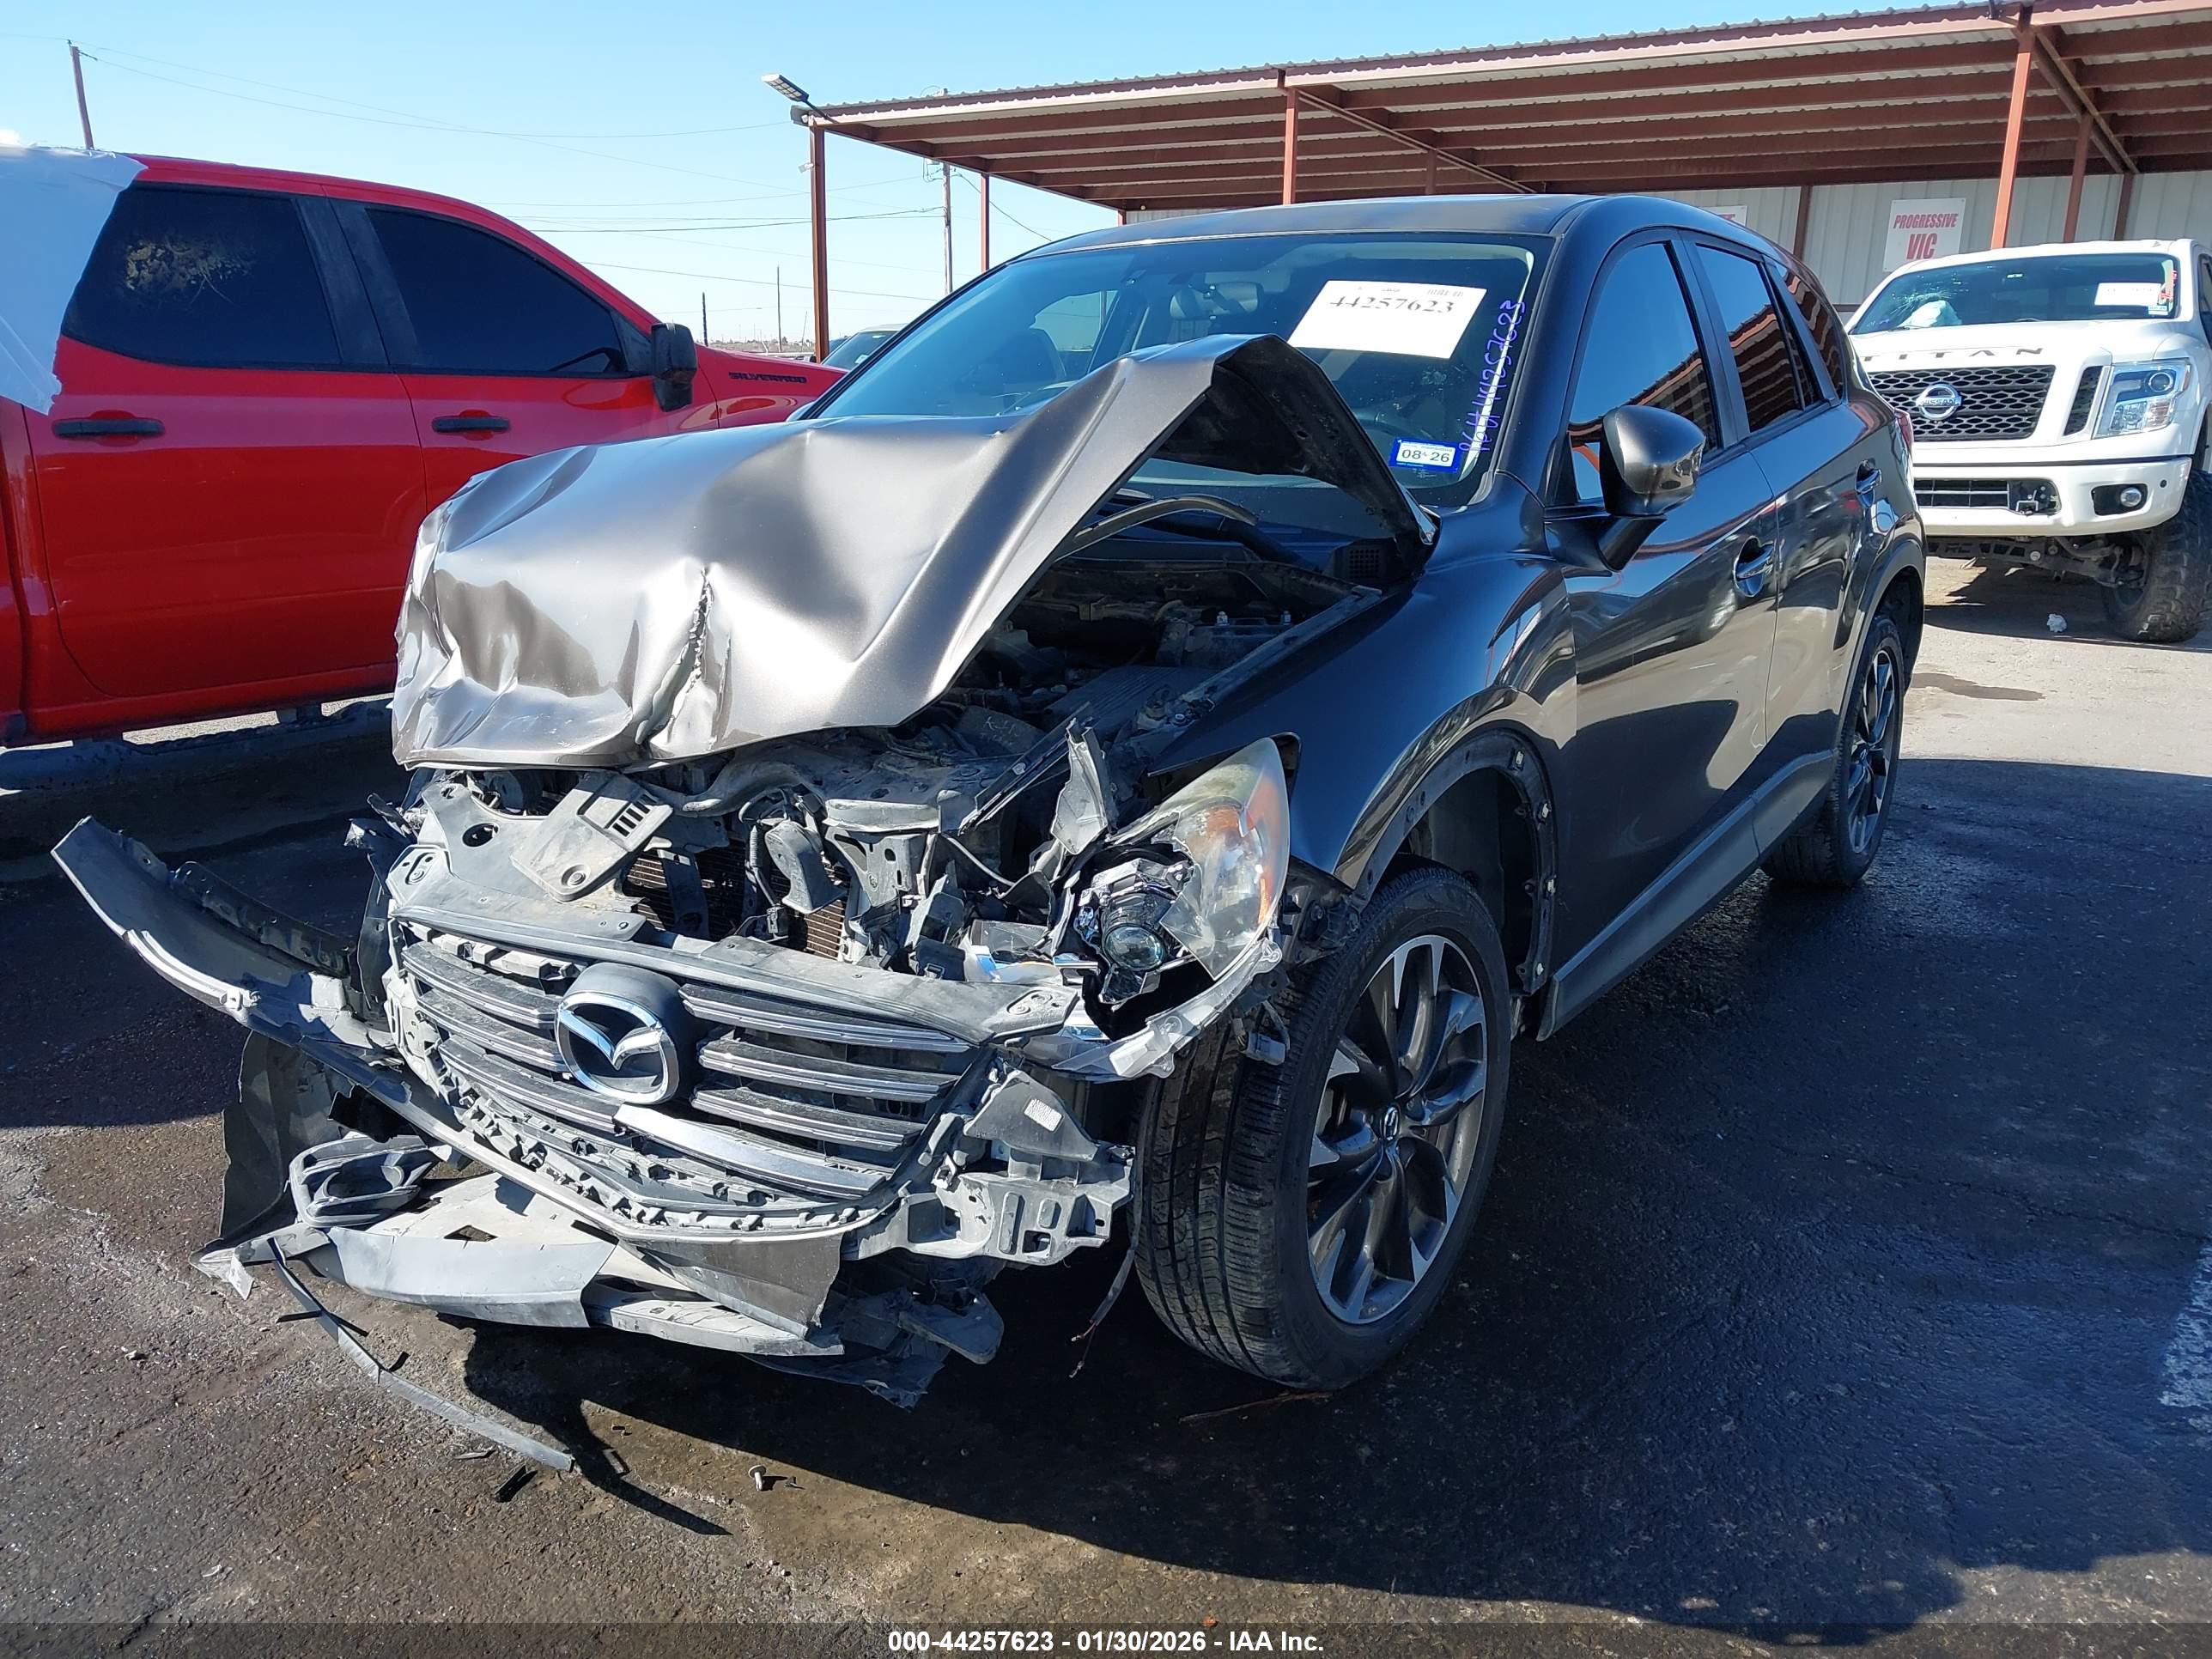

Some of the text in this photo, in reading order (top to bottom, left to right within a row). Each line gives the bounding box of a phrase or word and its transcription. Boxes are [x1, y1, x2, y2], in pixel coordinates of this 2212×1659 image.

[1893, 213, 1959, 229] PROGRESSIVE
[1906, 233, 1938, 259] VIC
[1329, 295, 1455, 313] 44257623
[1860, 347, 2044, 362] TITAN
[728, 372, 807, 384] SILVERADO
[1401, 449, 1450, 463] 08 26
